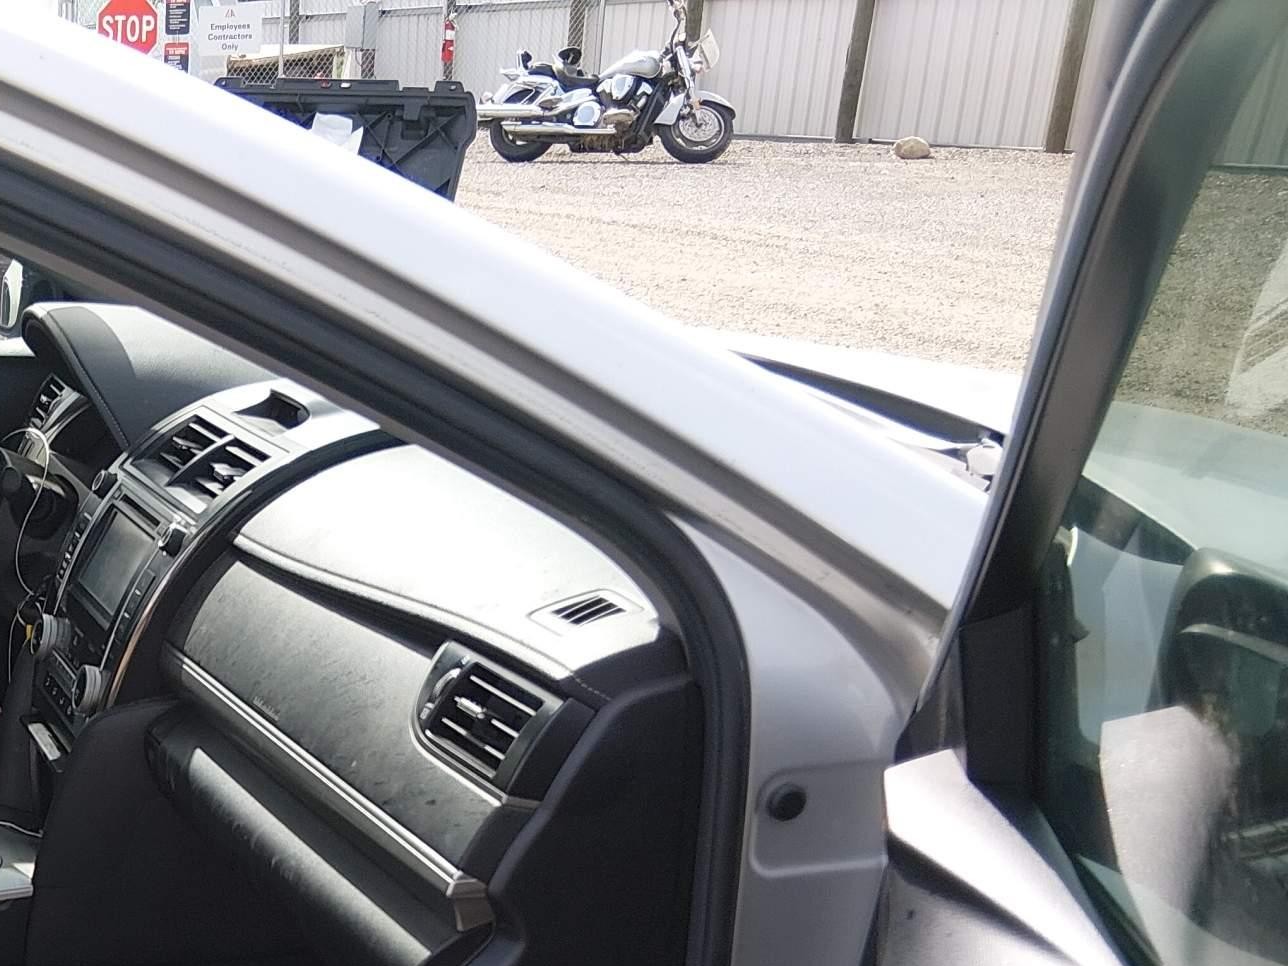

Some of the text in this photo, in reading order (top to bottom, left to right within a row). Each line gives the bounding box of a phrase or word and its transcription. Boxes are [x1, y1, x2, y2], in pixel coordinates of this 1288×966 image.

[102, 14, 155, 43] STOP
[210, 23, 251, 31] Employees
[207, 33, 253, 41] Contractors
[221, 43, 239, 51] Only
